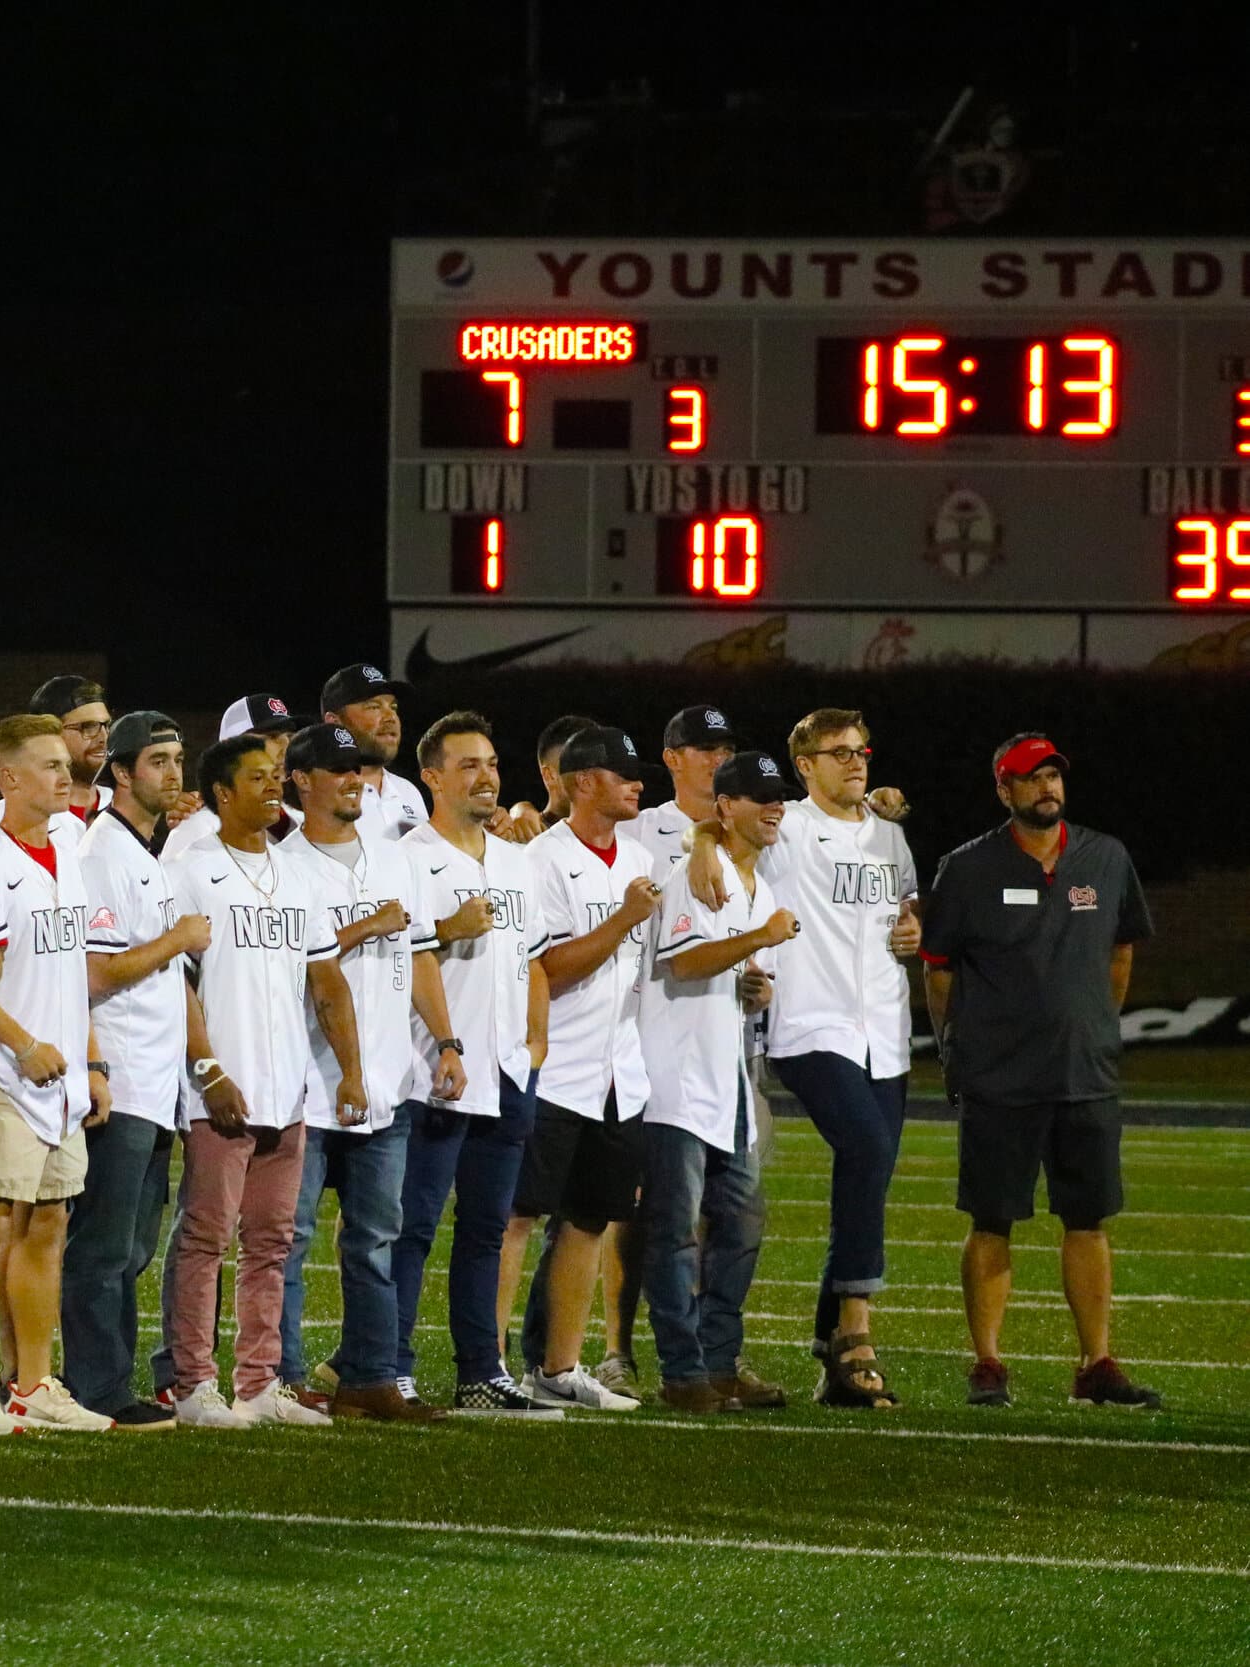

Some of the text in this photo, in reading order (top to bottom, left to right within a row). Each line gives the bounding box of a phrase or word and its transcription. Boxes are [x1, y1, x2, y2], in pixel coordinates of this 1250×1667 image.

[538, 252, 920, 298] YOUNTS
[460, 325, 635, 361] CRUSADERS
[481, 370, 521, 446] 7
[863, 337, 1114, 435] 15:13
[667, 388, 703, 451] 3
[424, 464, 524, 512] DOWN
[629, 466, 806, 513] YDS TO GO
[1149, 468, 1224, 514] BALL
[486, 519, 500, 590] 1
[690, 515, 759, 597] 10
[833, 861, 899, 905] NGU
[31, 904, 87, 955] NGU
[230, 904, 306, 951] NGU
[393, 951, 406, 992] 5
